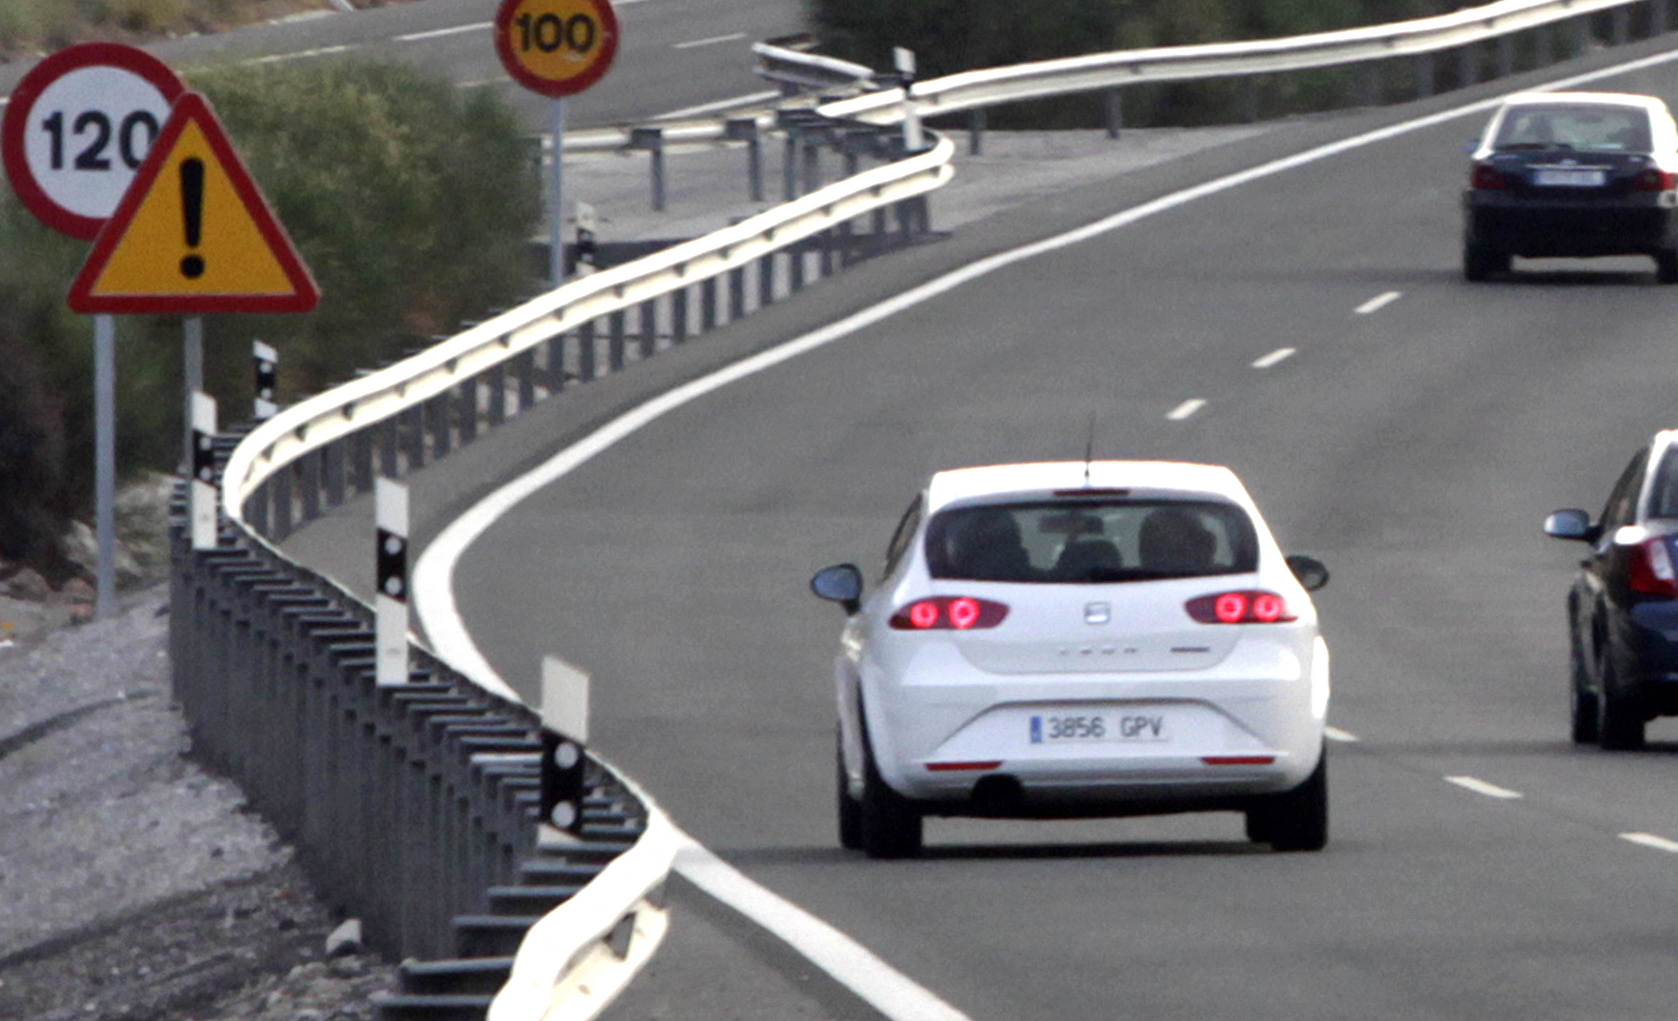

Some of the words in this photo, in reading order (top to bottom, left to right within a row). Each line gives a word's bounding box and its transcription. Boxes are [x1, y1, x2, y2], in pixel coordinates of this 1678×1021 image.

[515, 12, 596, 53] 100
[42, 110, 160, 171] 120
[1048, 716, 1105, 738] 3856
[1120, 716, 1162, 737] GPV
